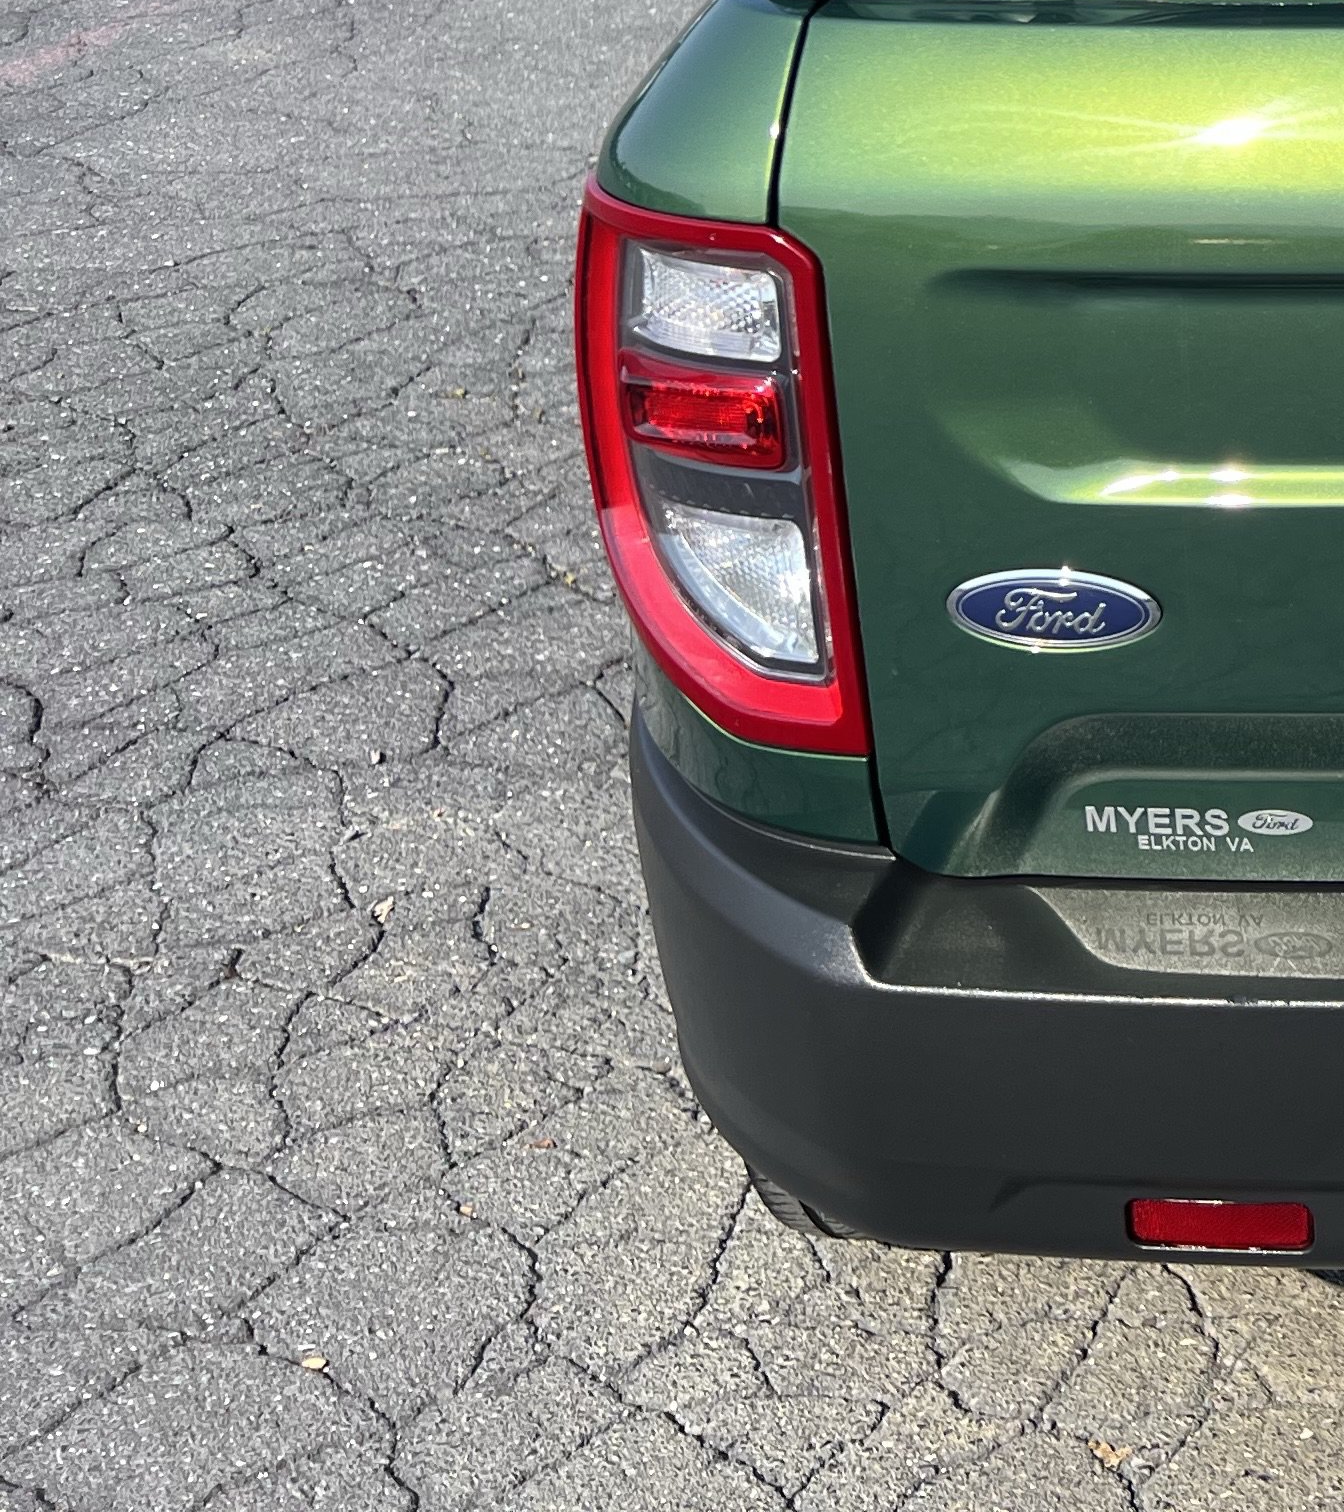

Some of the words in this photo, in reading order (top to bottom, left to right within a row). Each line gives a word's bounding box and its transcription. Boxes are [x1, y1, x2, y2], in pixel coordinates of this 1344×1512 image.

[995, 587, 1106, 634] Ford
[1084, 805, 1231, 836] MYERS
[1251, 812, 1300, 832] Ford
[1137, 834, 1216, 852] ELKTON
[1226, 837, 1255, 853] VA
